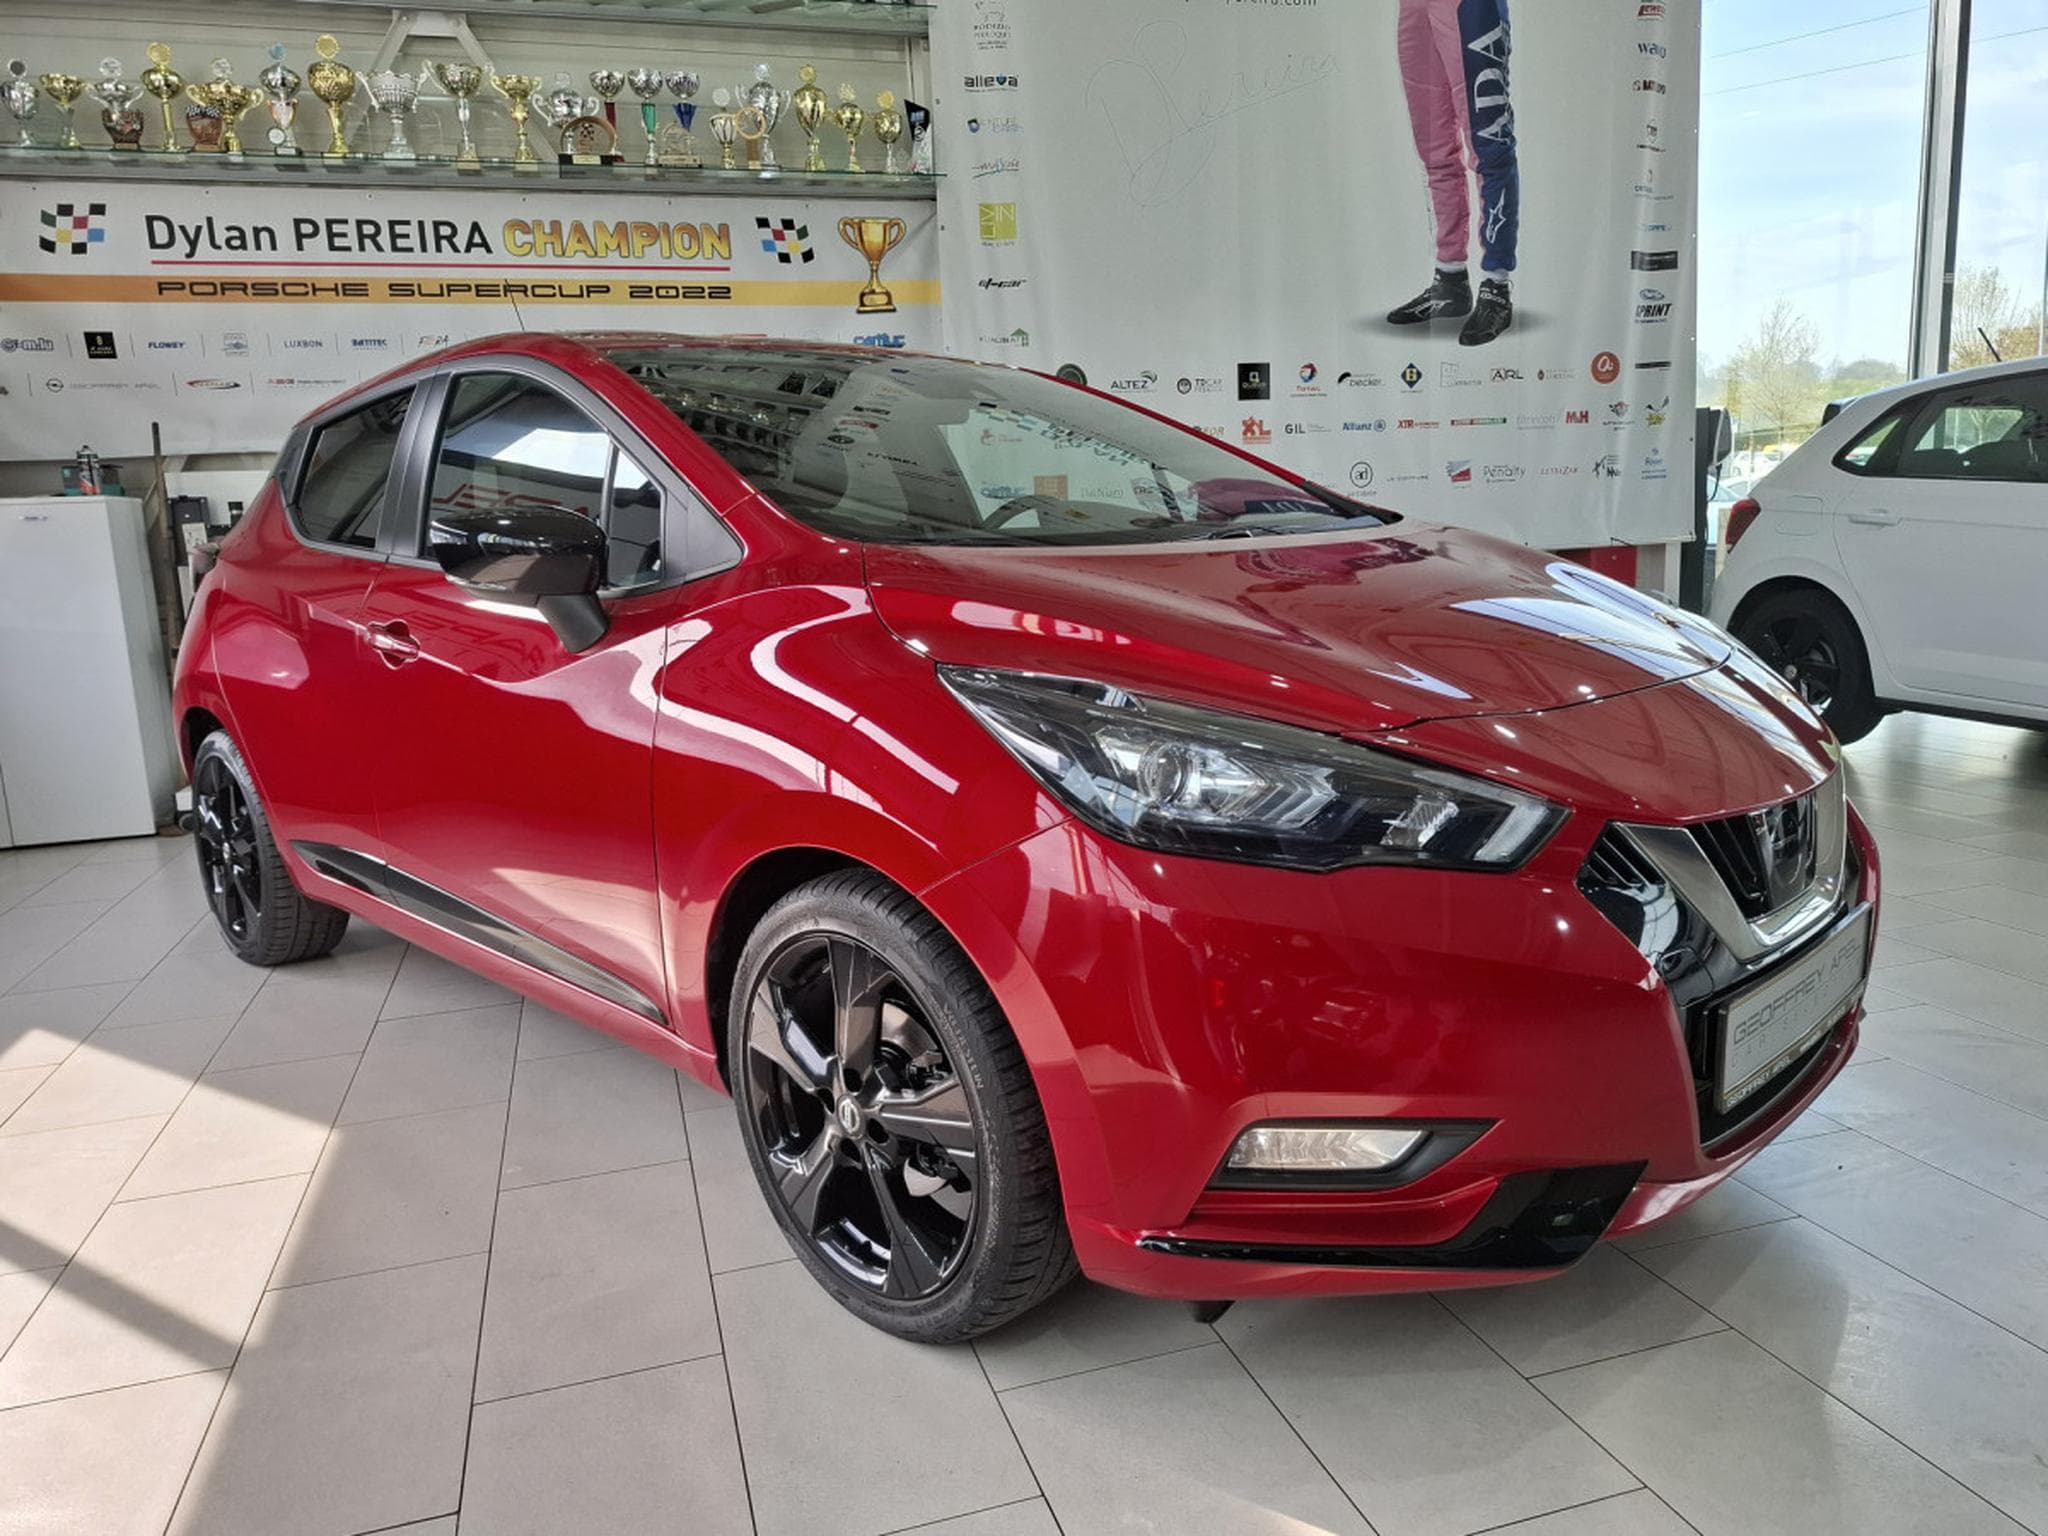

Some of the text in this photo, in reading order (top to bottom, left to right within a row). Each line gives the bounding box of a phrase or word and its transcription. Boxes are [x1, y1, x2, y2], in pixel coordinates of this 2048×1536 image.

[144, 214, 732, 260] Dylan PEREIRA CHAMPION
[157, 281, 732, 300] PORSCHE SUPERCUP 2022
[1110, 380, 1148, 390] ALTEZ
[1284, 423, 1306, 435] GIL
[1733, 966, 1825, 1045] GEOFFREY
